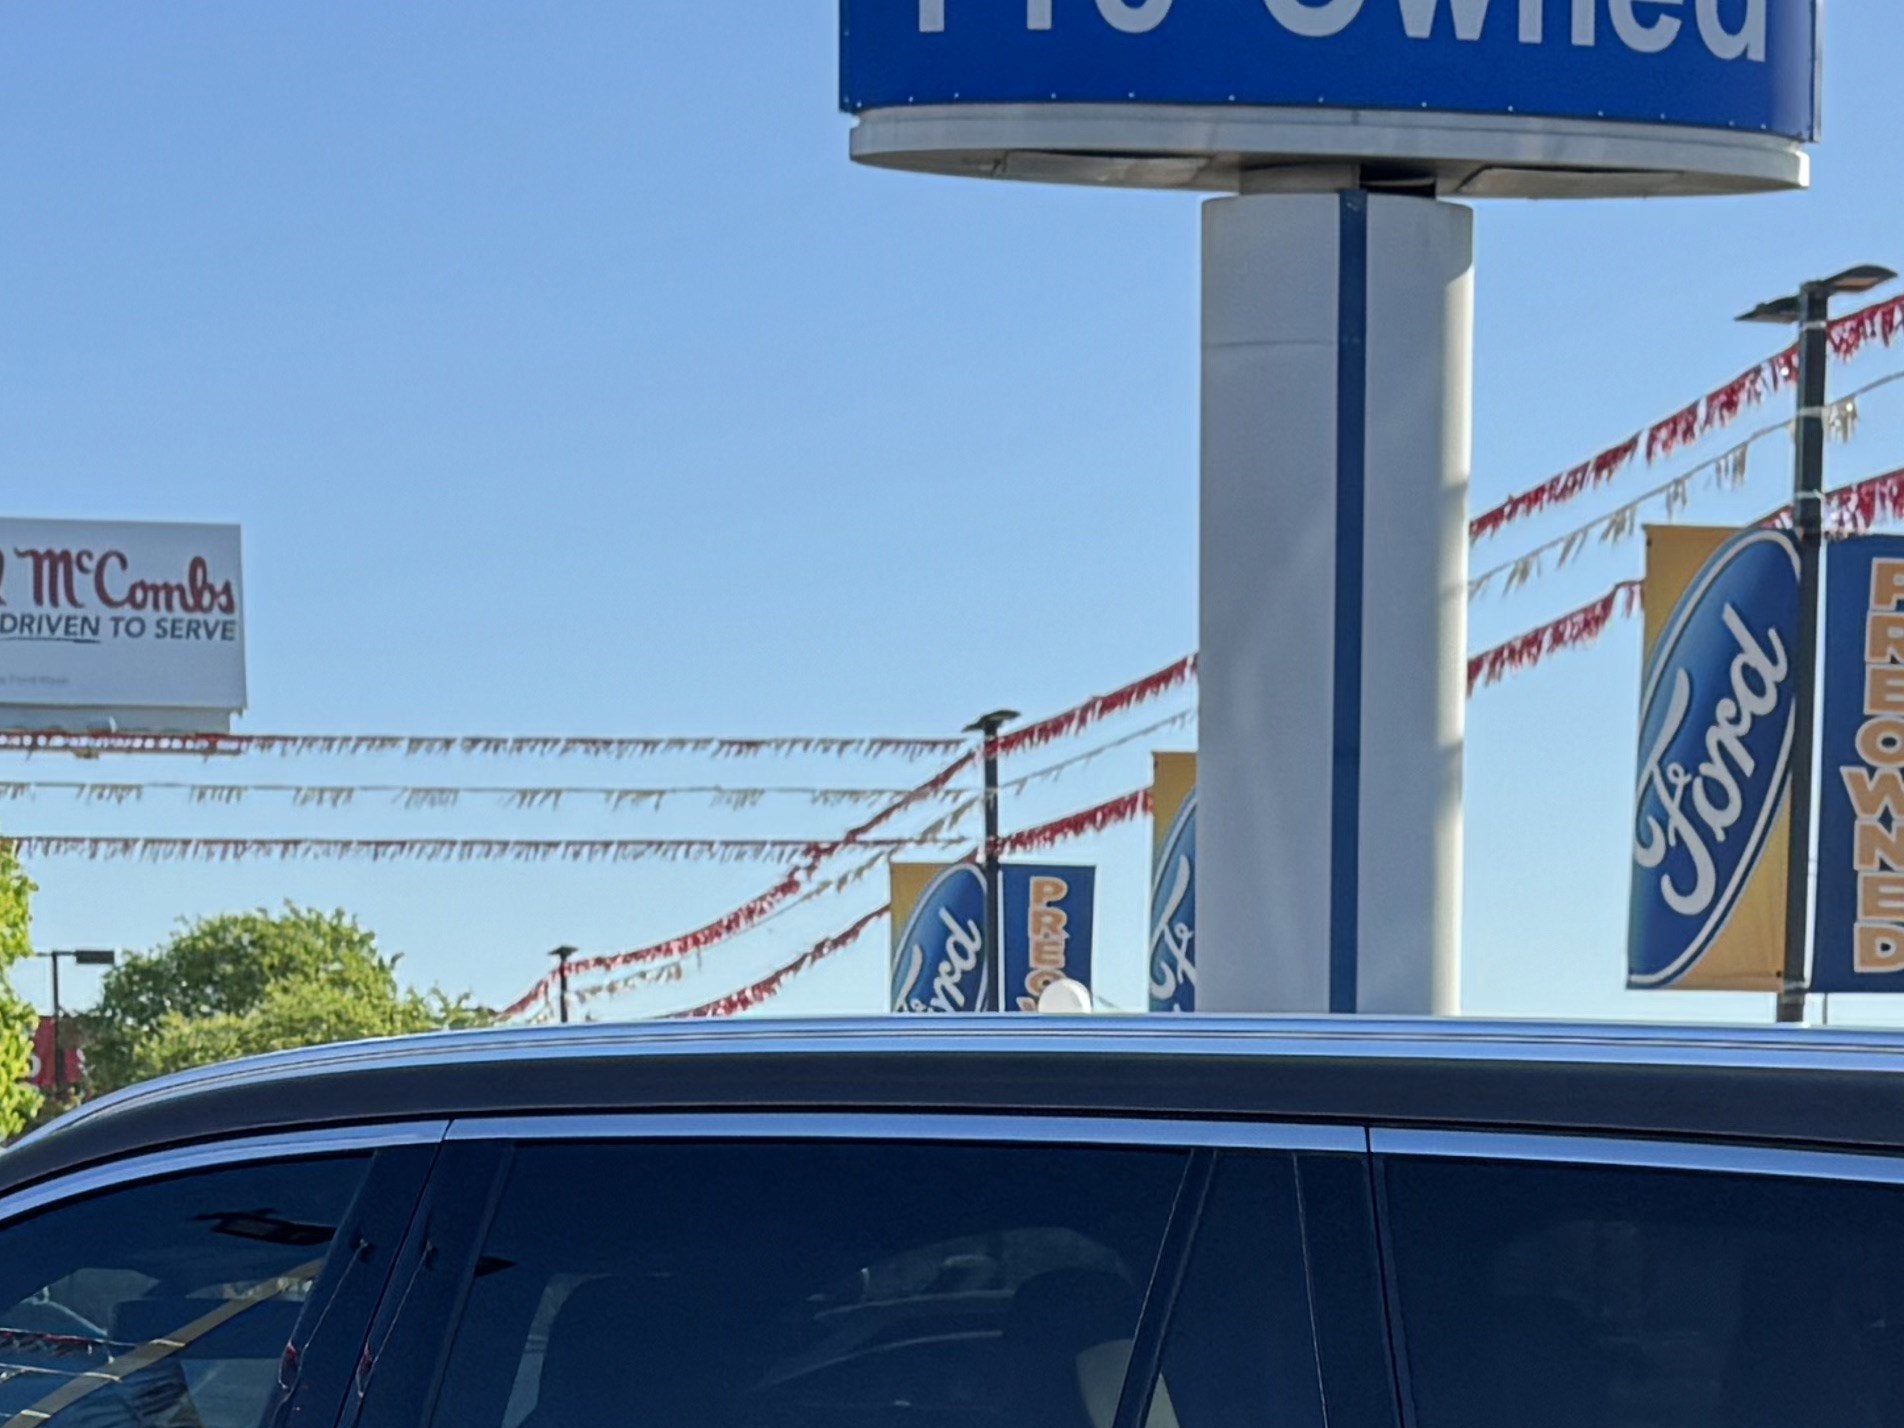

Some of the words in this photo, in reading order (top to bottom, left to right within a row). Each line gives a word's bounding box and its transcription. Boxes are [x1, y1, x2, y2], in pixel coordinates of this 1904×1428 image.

[15, 548, 235, 615] McCombs
[0, 612, 100, 638] DRIVEN
[112, 615, 146, 638] TO
[155, 617, 237, 642] SERVE
[1634, 603, 1788, 915] Ford
